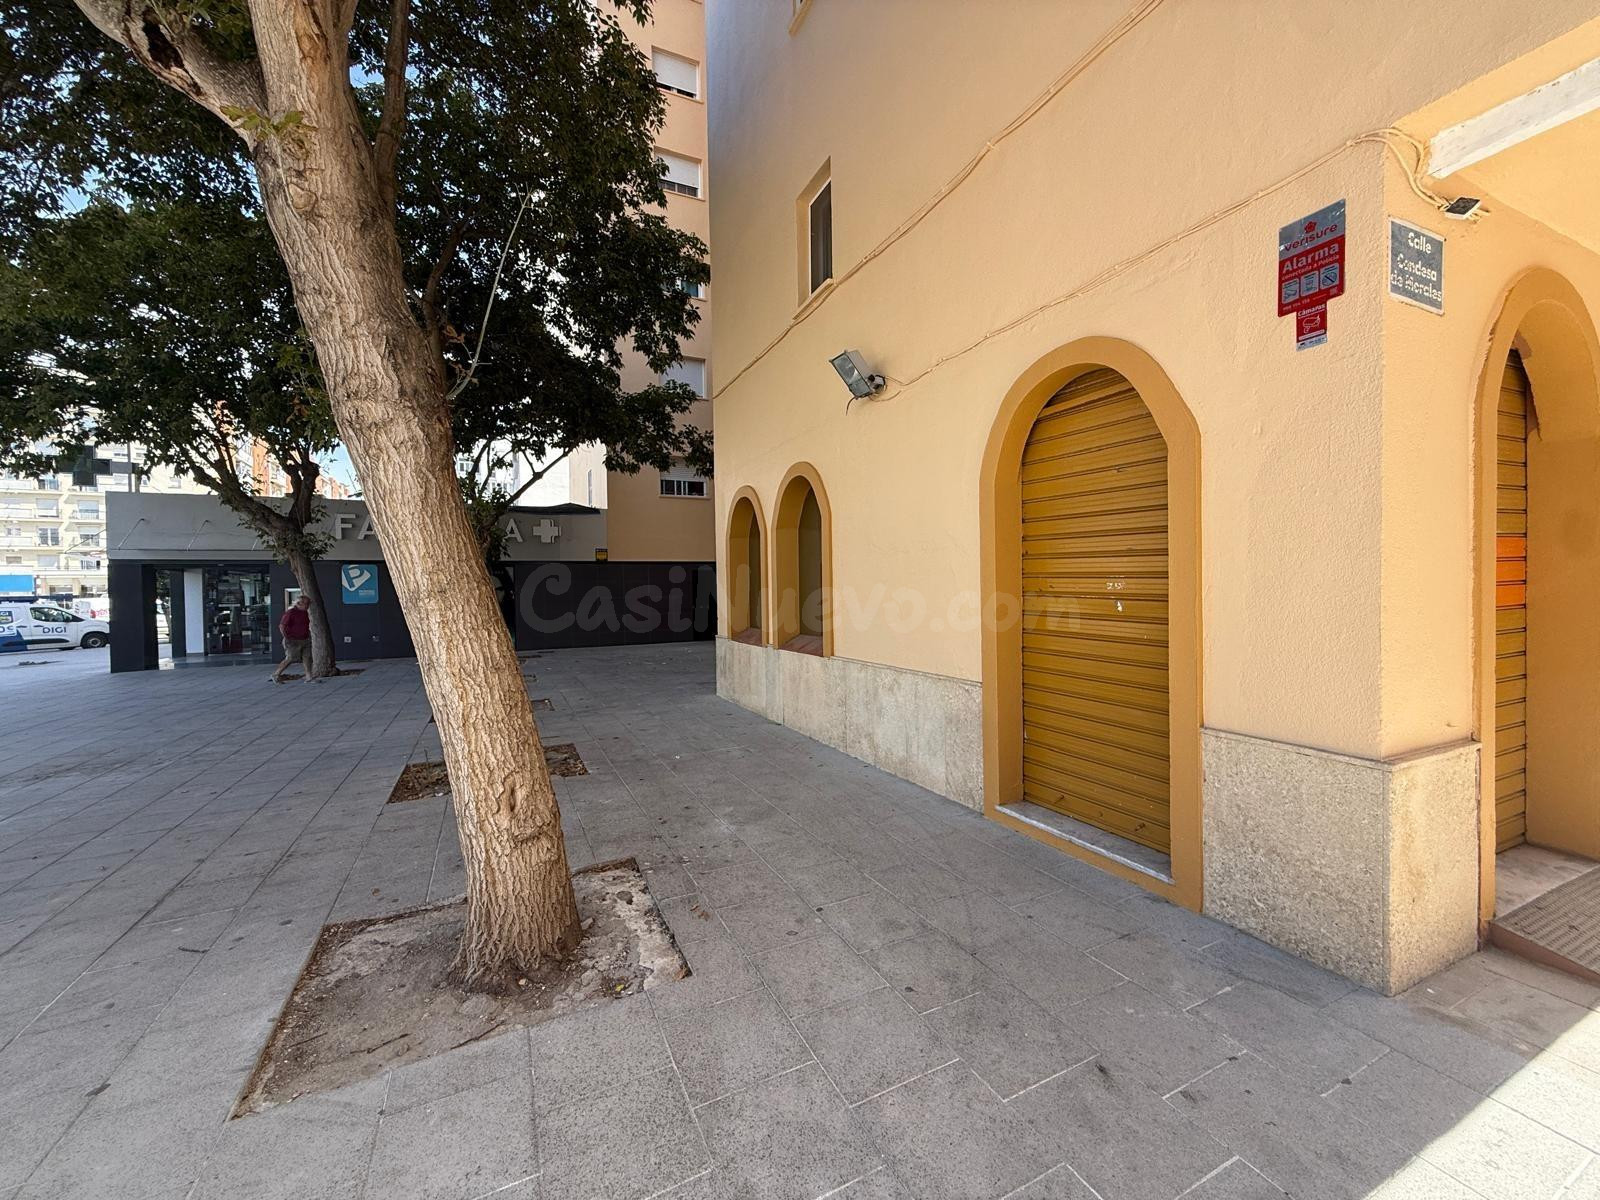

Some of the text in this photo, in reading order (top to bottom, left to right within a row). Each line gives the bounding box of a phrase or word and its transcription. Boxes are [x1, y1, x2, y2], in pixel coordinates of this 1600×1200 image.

[1284, 224, 1338, 251] verisure
[1407, 231, 1432, 254] Calle
[1282, 243, 1339, 274] Alarma
[1397, 252, 1437, 282] Condesa
[1391, 269, 1442, 302] de Morales
[42, 626, 67, 634] DIGI
